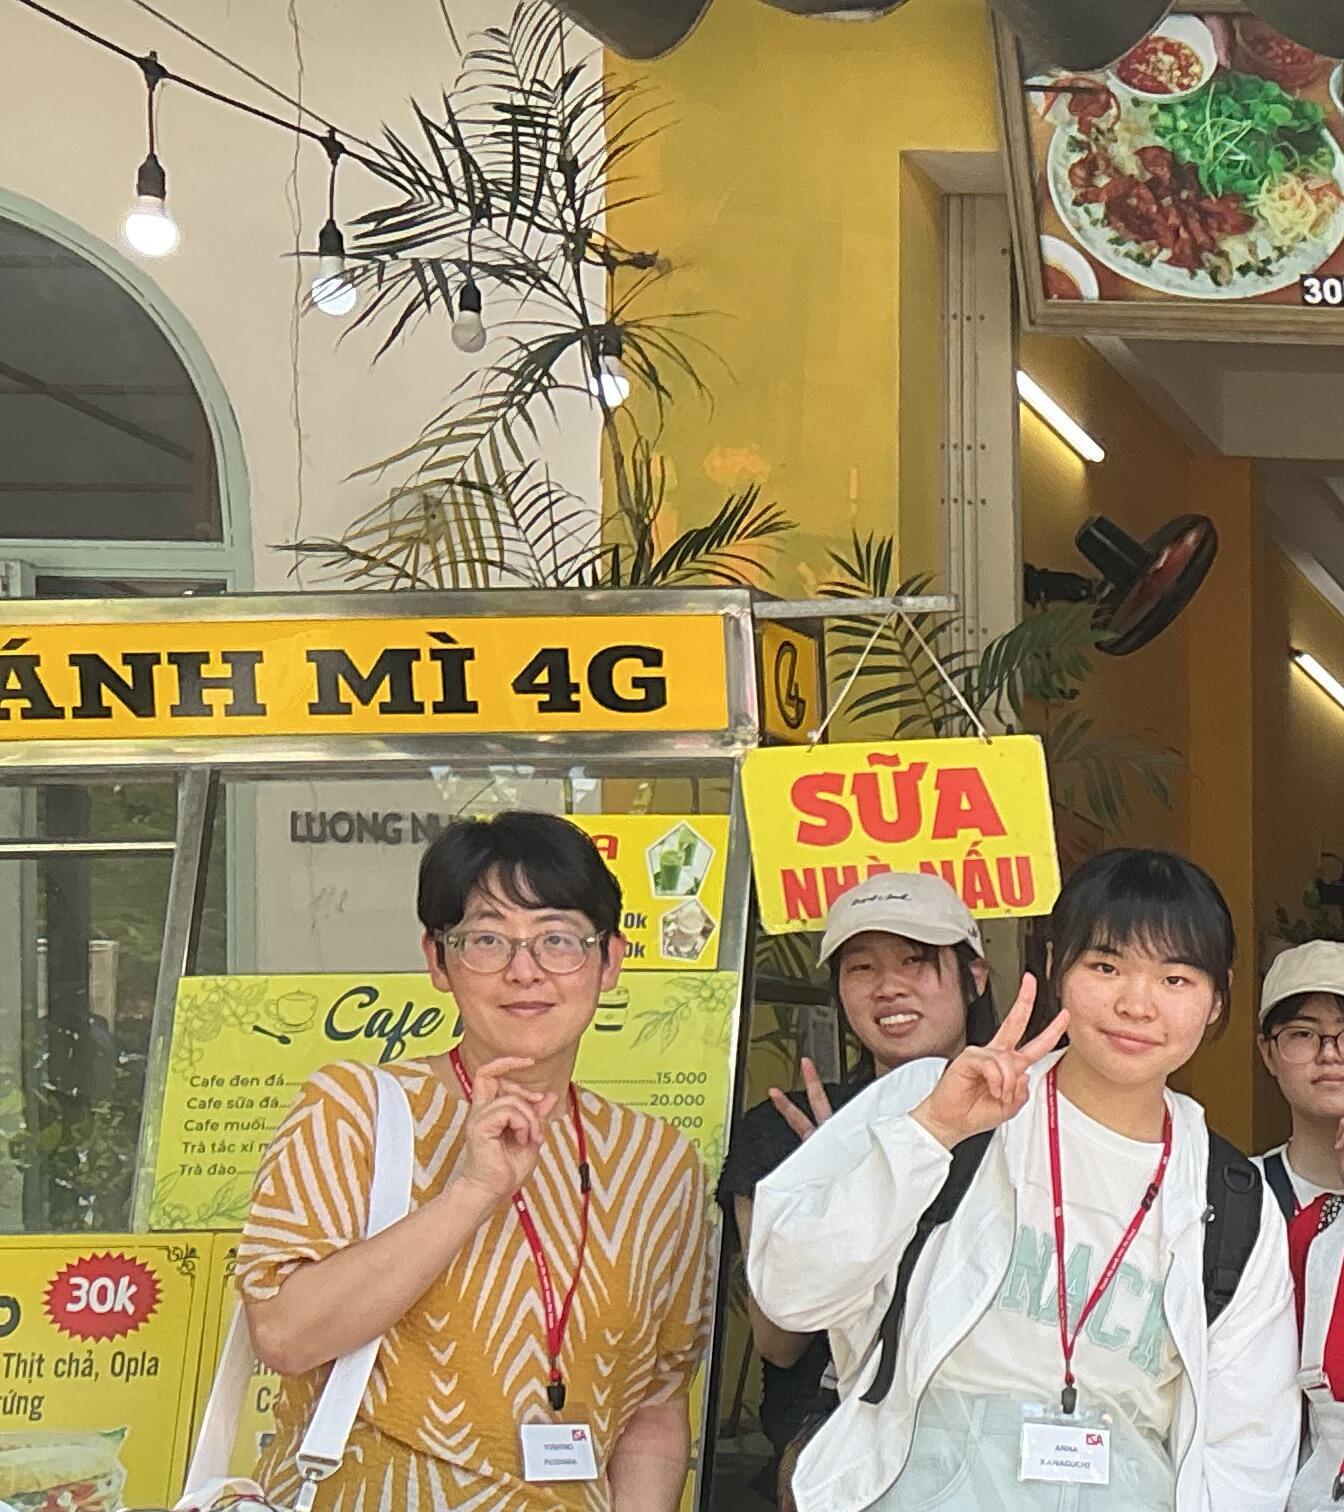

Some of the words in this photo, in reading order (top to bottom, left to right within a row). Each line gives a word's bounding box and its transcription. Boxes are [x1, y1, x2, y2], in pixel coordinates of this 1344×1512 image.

[0, 638, 267, 721] ÁNH
[307, 632, 479, 716] MÌ
[511, 645, 668, 713] 4G
[790, 752, 1008, 847] SỮA
[323, 985, 444, 1064] Cafe
[189, 1074, 226, 1088] Cafe
[264, 1073, 285, 1087] đá
[656, 1071, 708, 1085] 15.000
[186, 1097, 222, 1110] Cafe
[258, 1095, 279, 1109] đá
[650, 1093, 705, 1107] 20.000
[183, 1119, 220, 1132] Cafe
[182, 1141, 206, 1153] Trà
[179, 1163, 203, 1176] Trà
[206, 1163, 237, 1175] đào
[65, 1274, 138, 1316] 30k
[2, 1352, 45, 1383] Thịt
[54, 1350, 99, 1382] chả,
[111, 1351, 159, 1383] Opla
[0, 1389, 45, 1421] ứng
